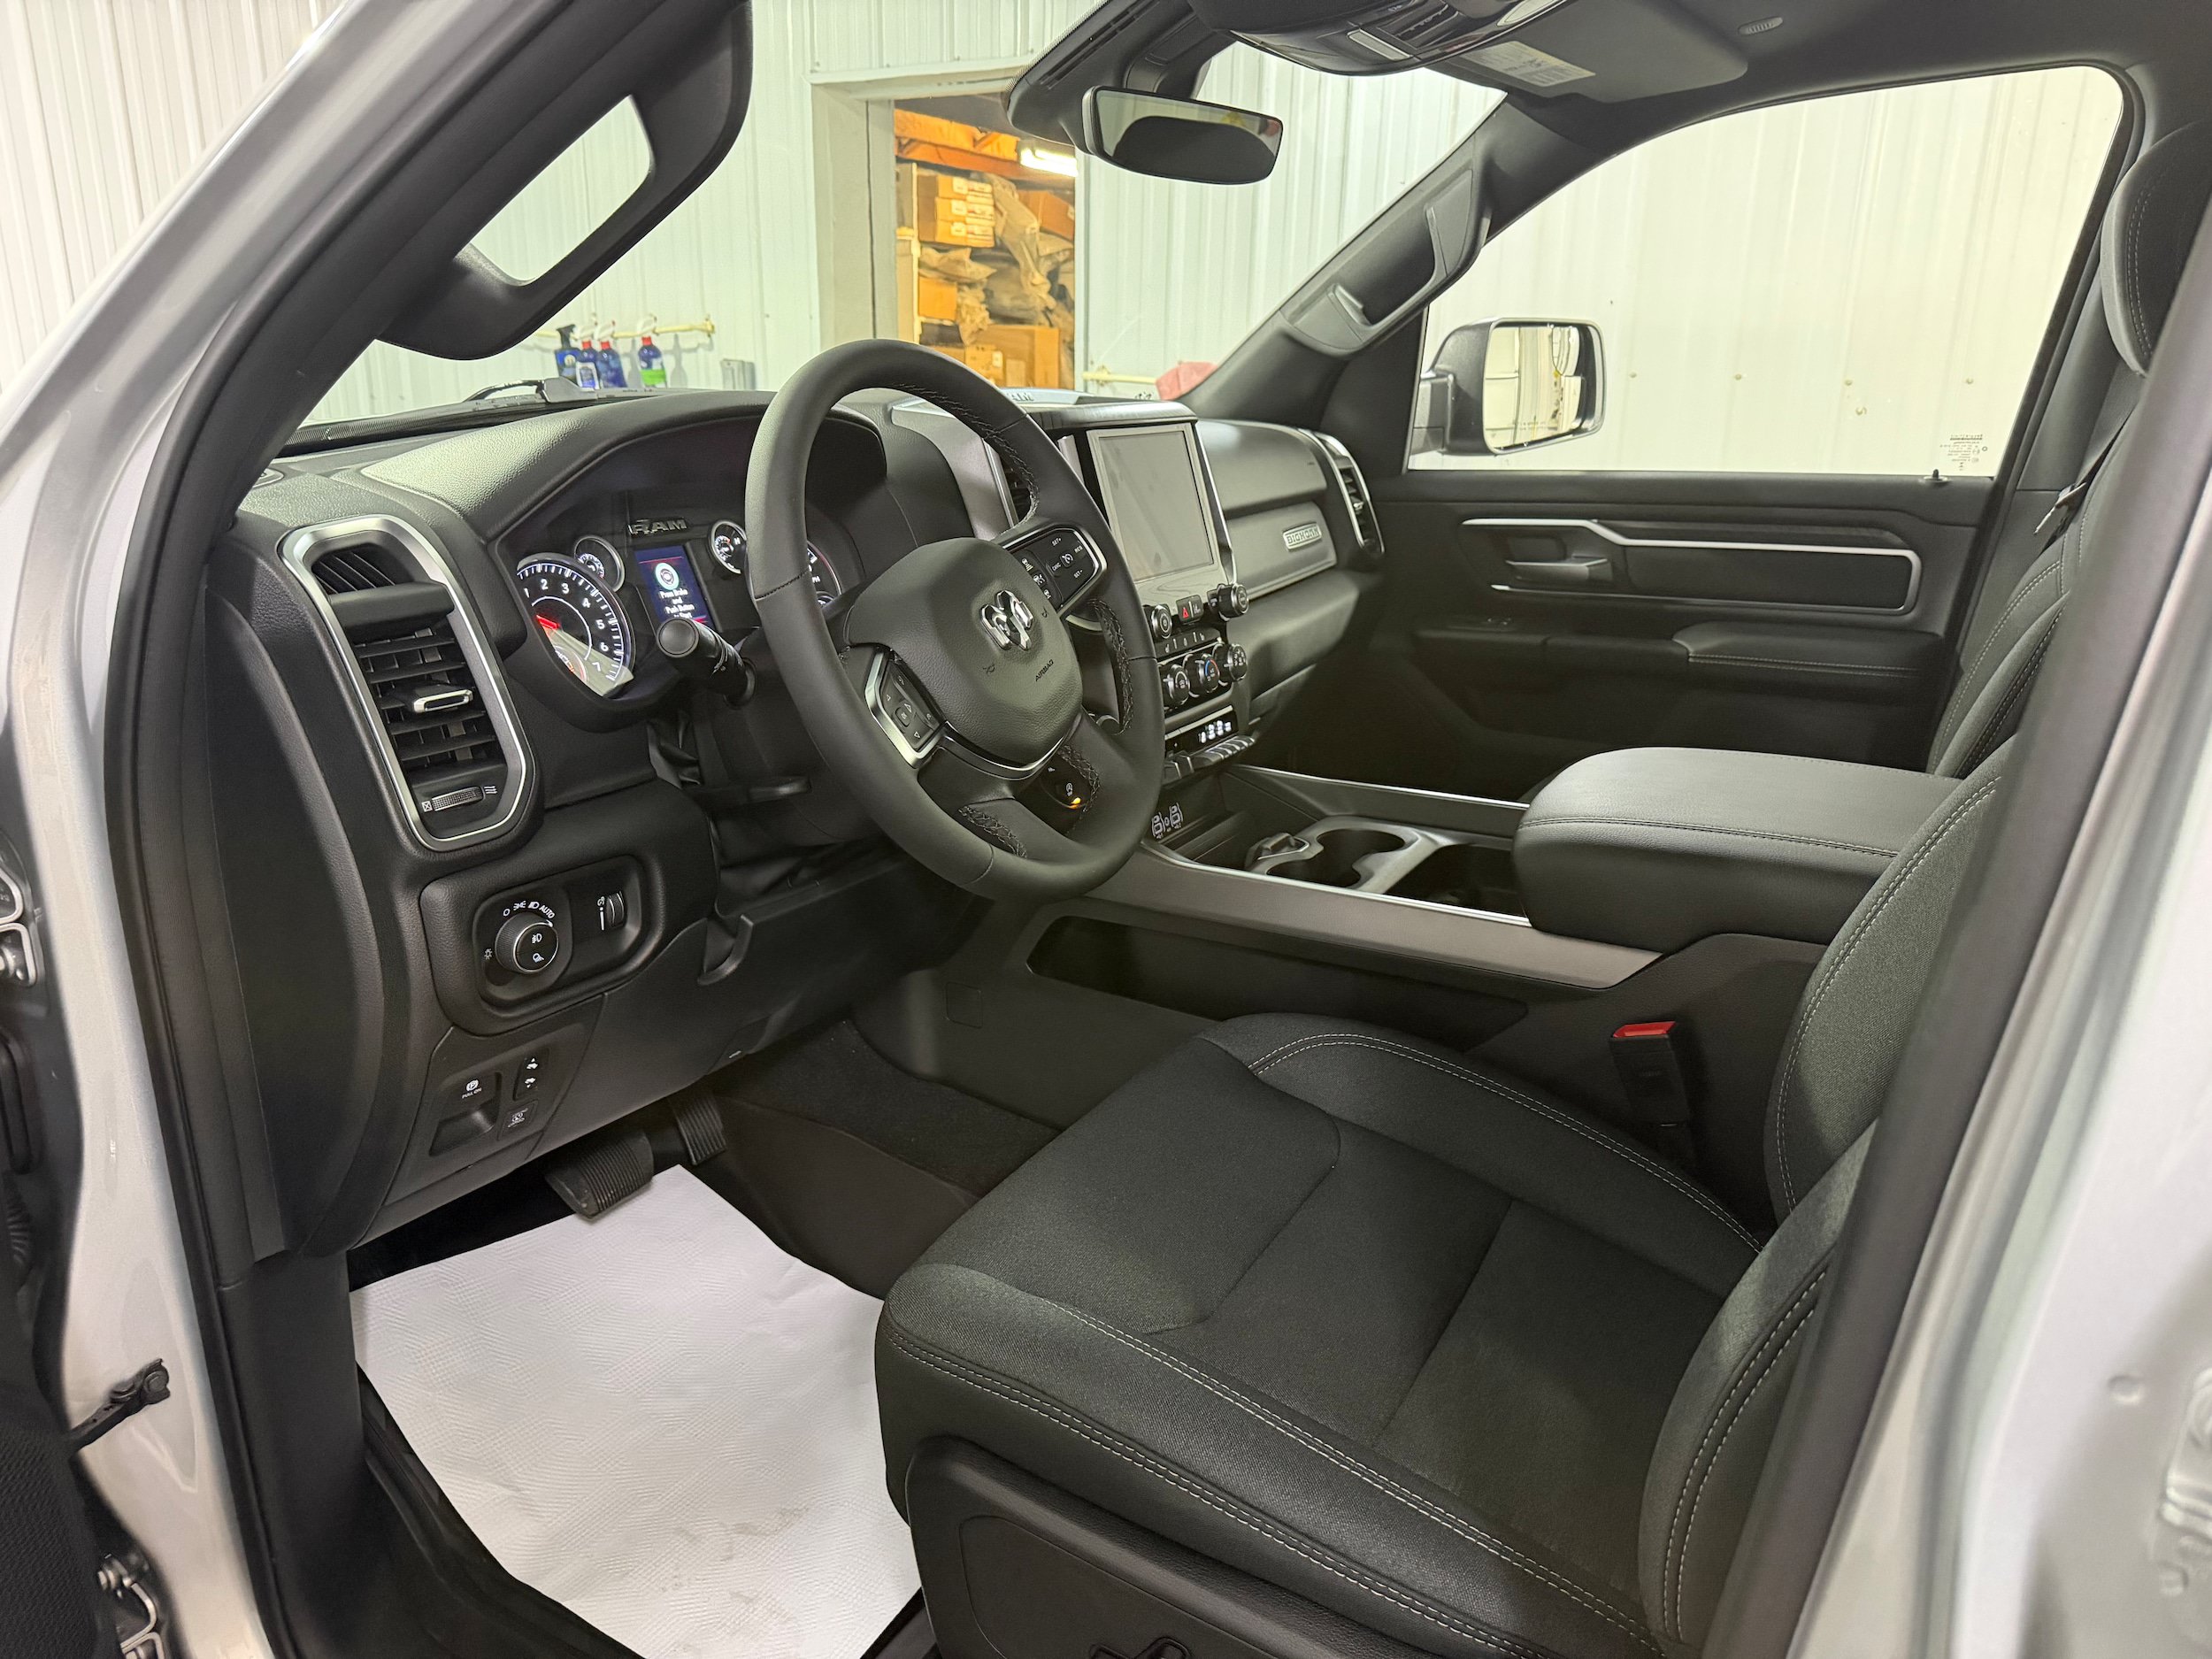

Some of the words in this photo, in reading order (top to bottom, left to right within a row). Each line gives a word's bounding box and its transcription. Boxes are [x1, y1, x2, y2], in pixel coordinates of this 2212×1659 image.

[627, 518, 687, 534] RAM
[540, 578, 549, 591] 2
[561, 582, 570, 595] 3
[524, 588, 530, 598] 1
[582, 597, 591, 609] 4
[595, 618, 605, 630] 5
[600, 641, 609, 652] 6
[539, 905, 556, 919] AUTO
